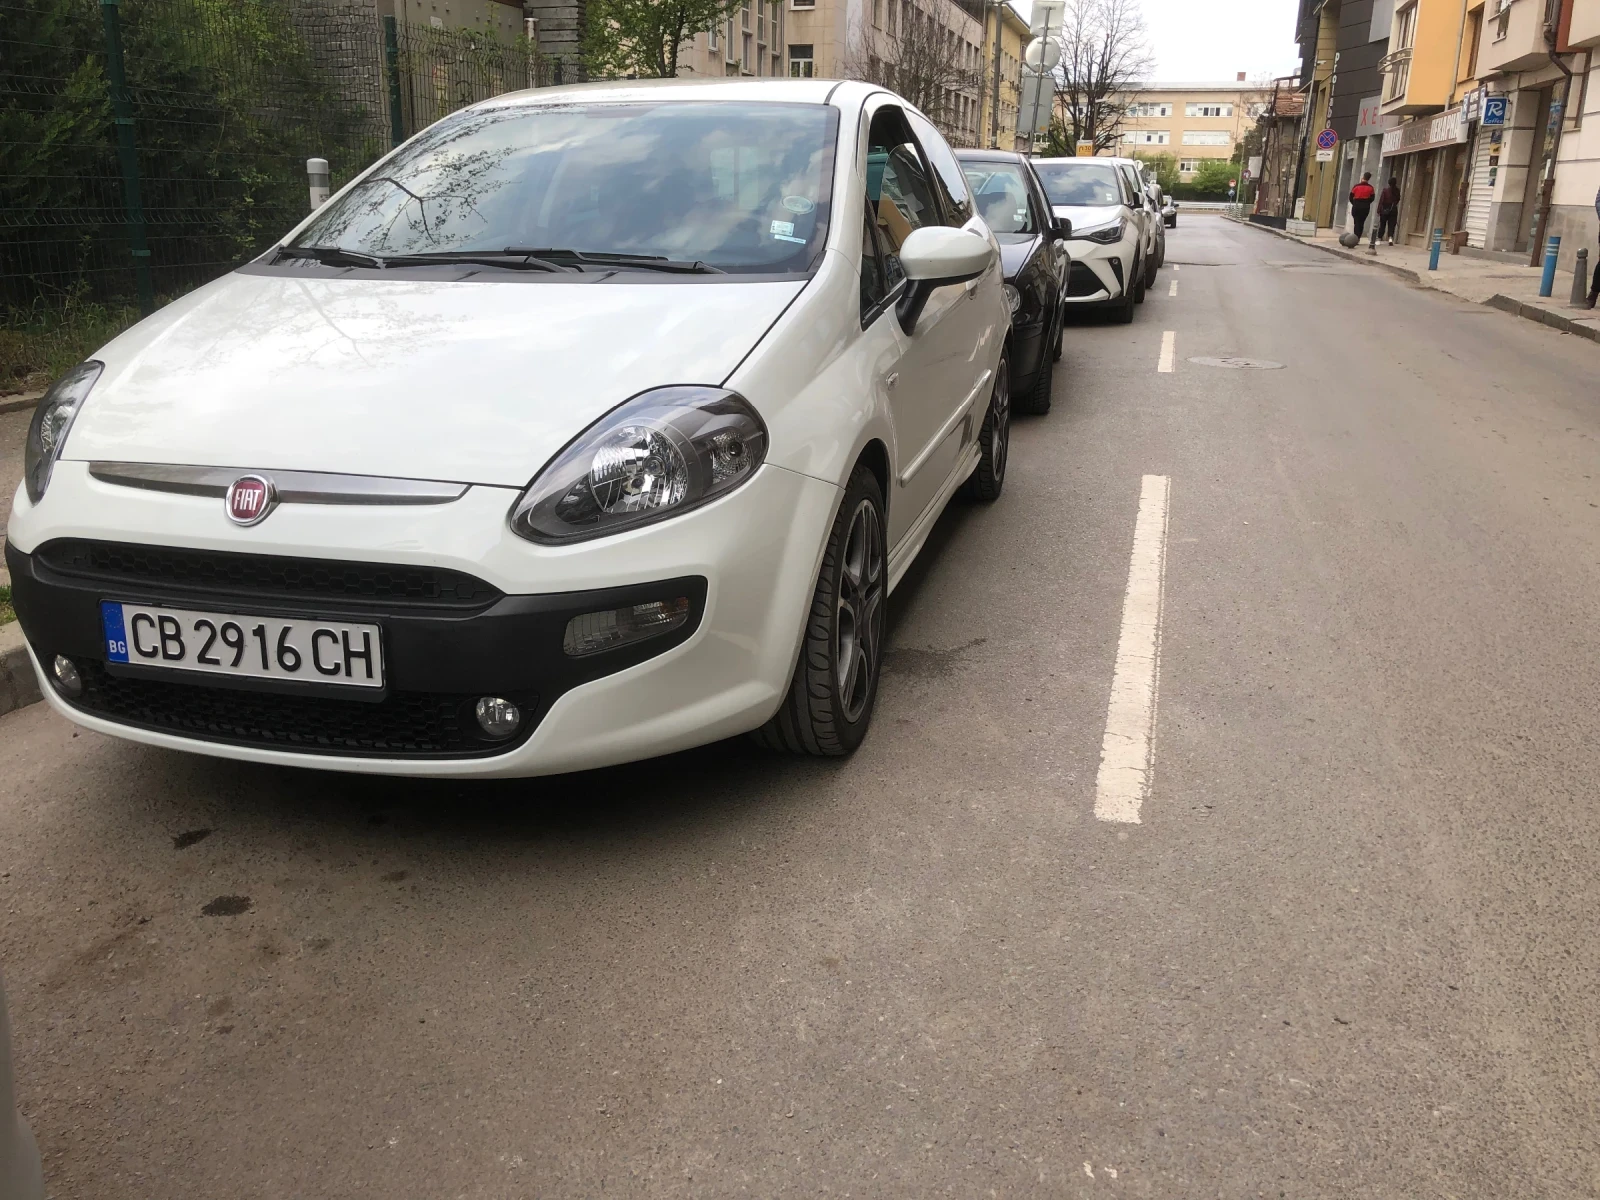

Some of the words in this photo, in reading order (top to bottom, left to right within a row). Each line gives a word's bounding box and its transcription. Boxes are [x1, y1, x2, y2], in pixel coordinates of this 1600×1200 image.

[233, 488, 262, 511] FIAT
[108, 639, 126, 654] BG
[131, 613, 185, 661] CB
[193, 619, 302, 672] 2916
[311, 628, 373, 679] CH
